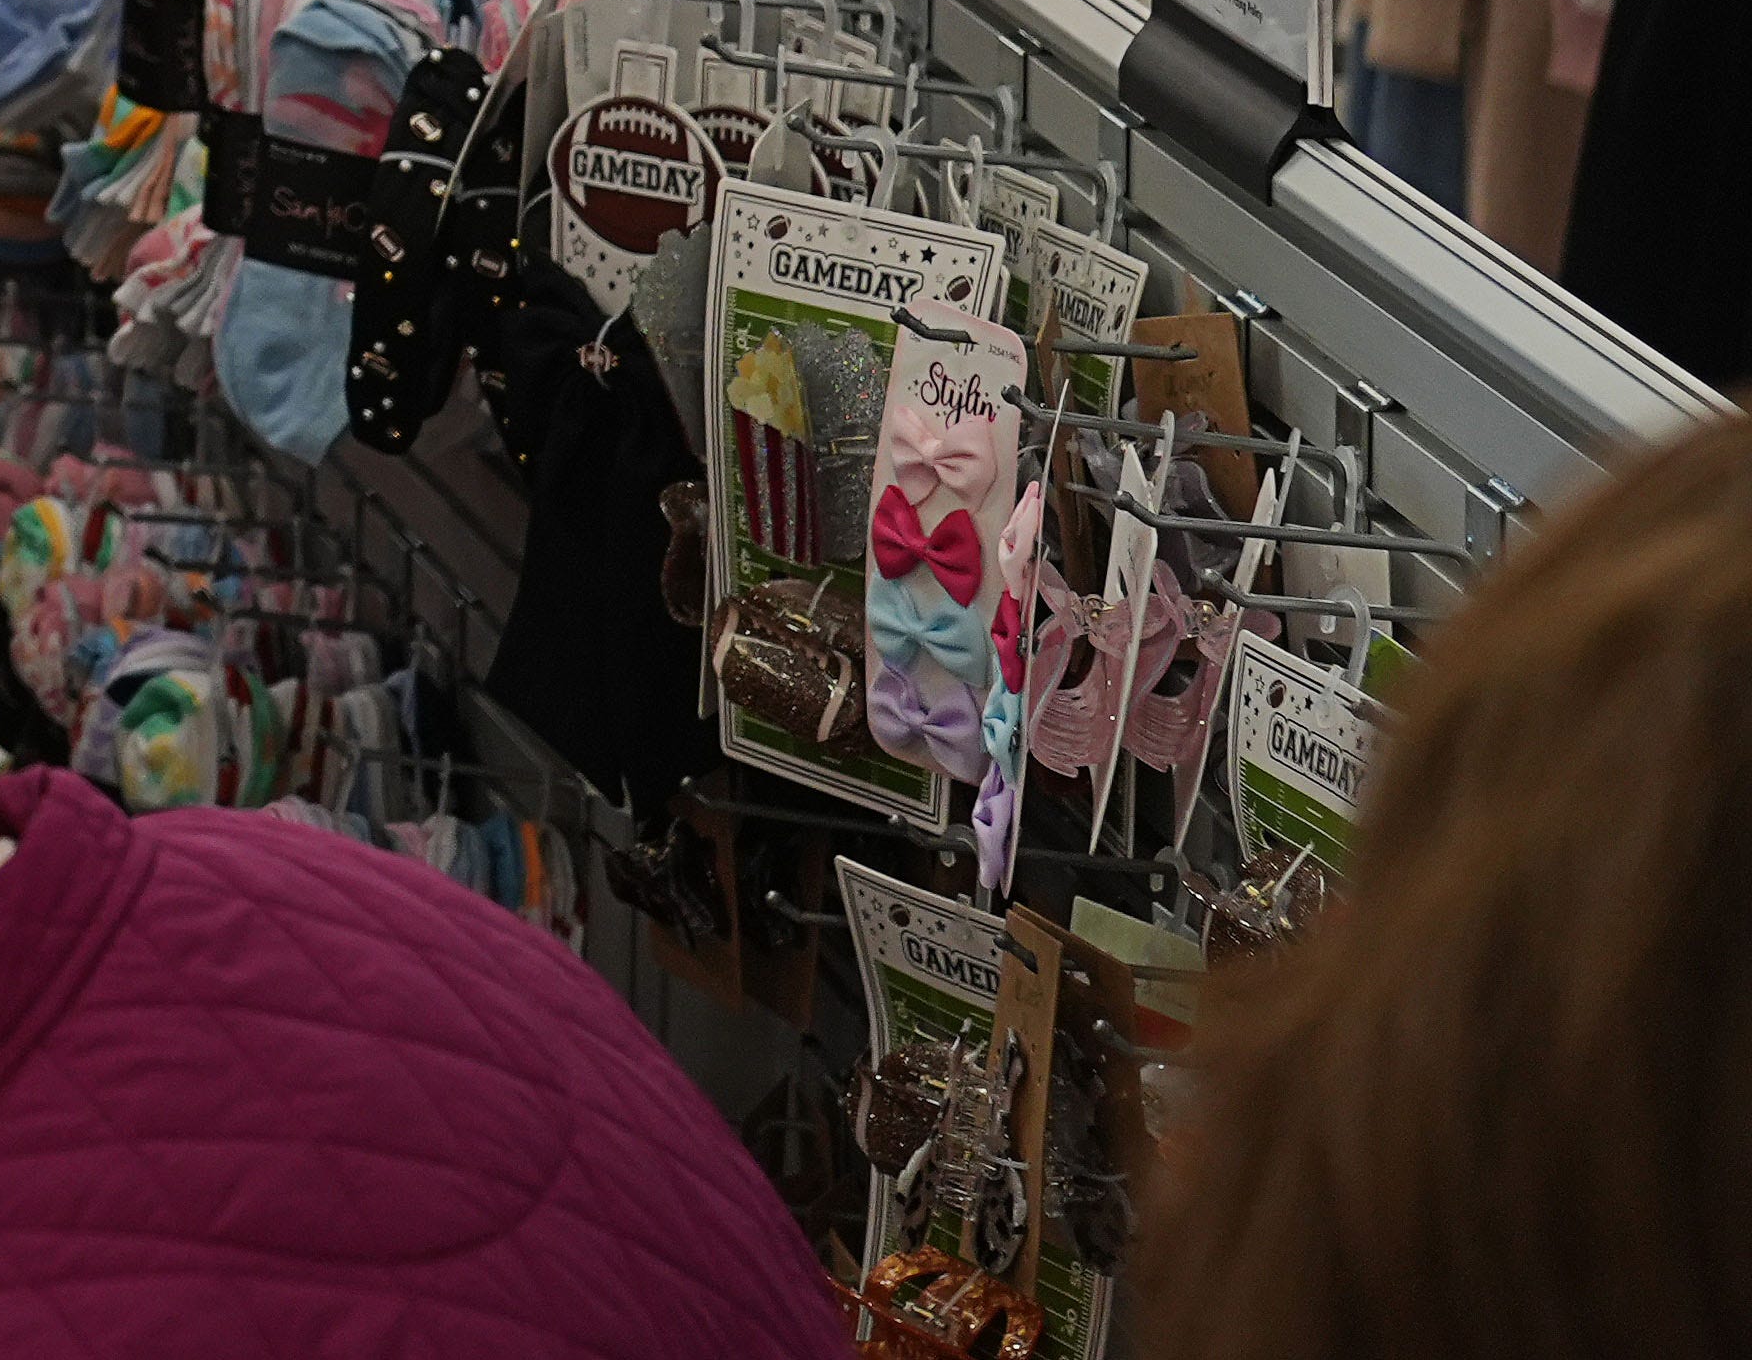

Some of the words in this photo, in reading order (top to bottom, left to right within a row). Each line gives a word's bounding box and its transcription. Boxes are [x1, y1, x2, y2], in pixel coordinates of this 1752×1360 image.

[573, 148, 701, 199] GAMEDAY
[774, 244, 918, 304] GAMEDAY
[1054, 287, 1106, 335] AMEDAY
[1271, 717, 1365, 802] GAMEDAY
